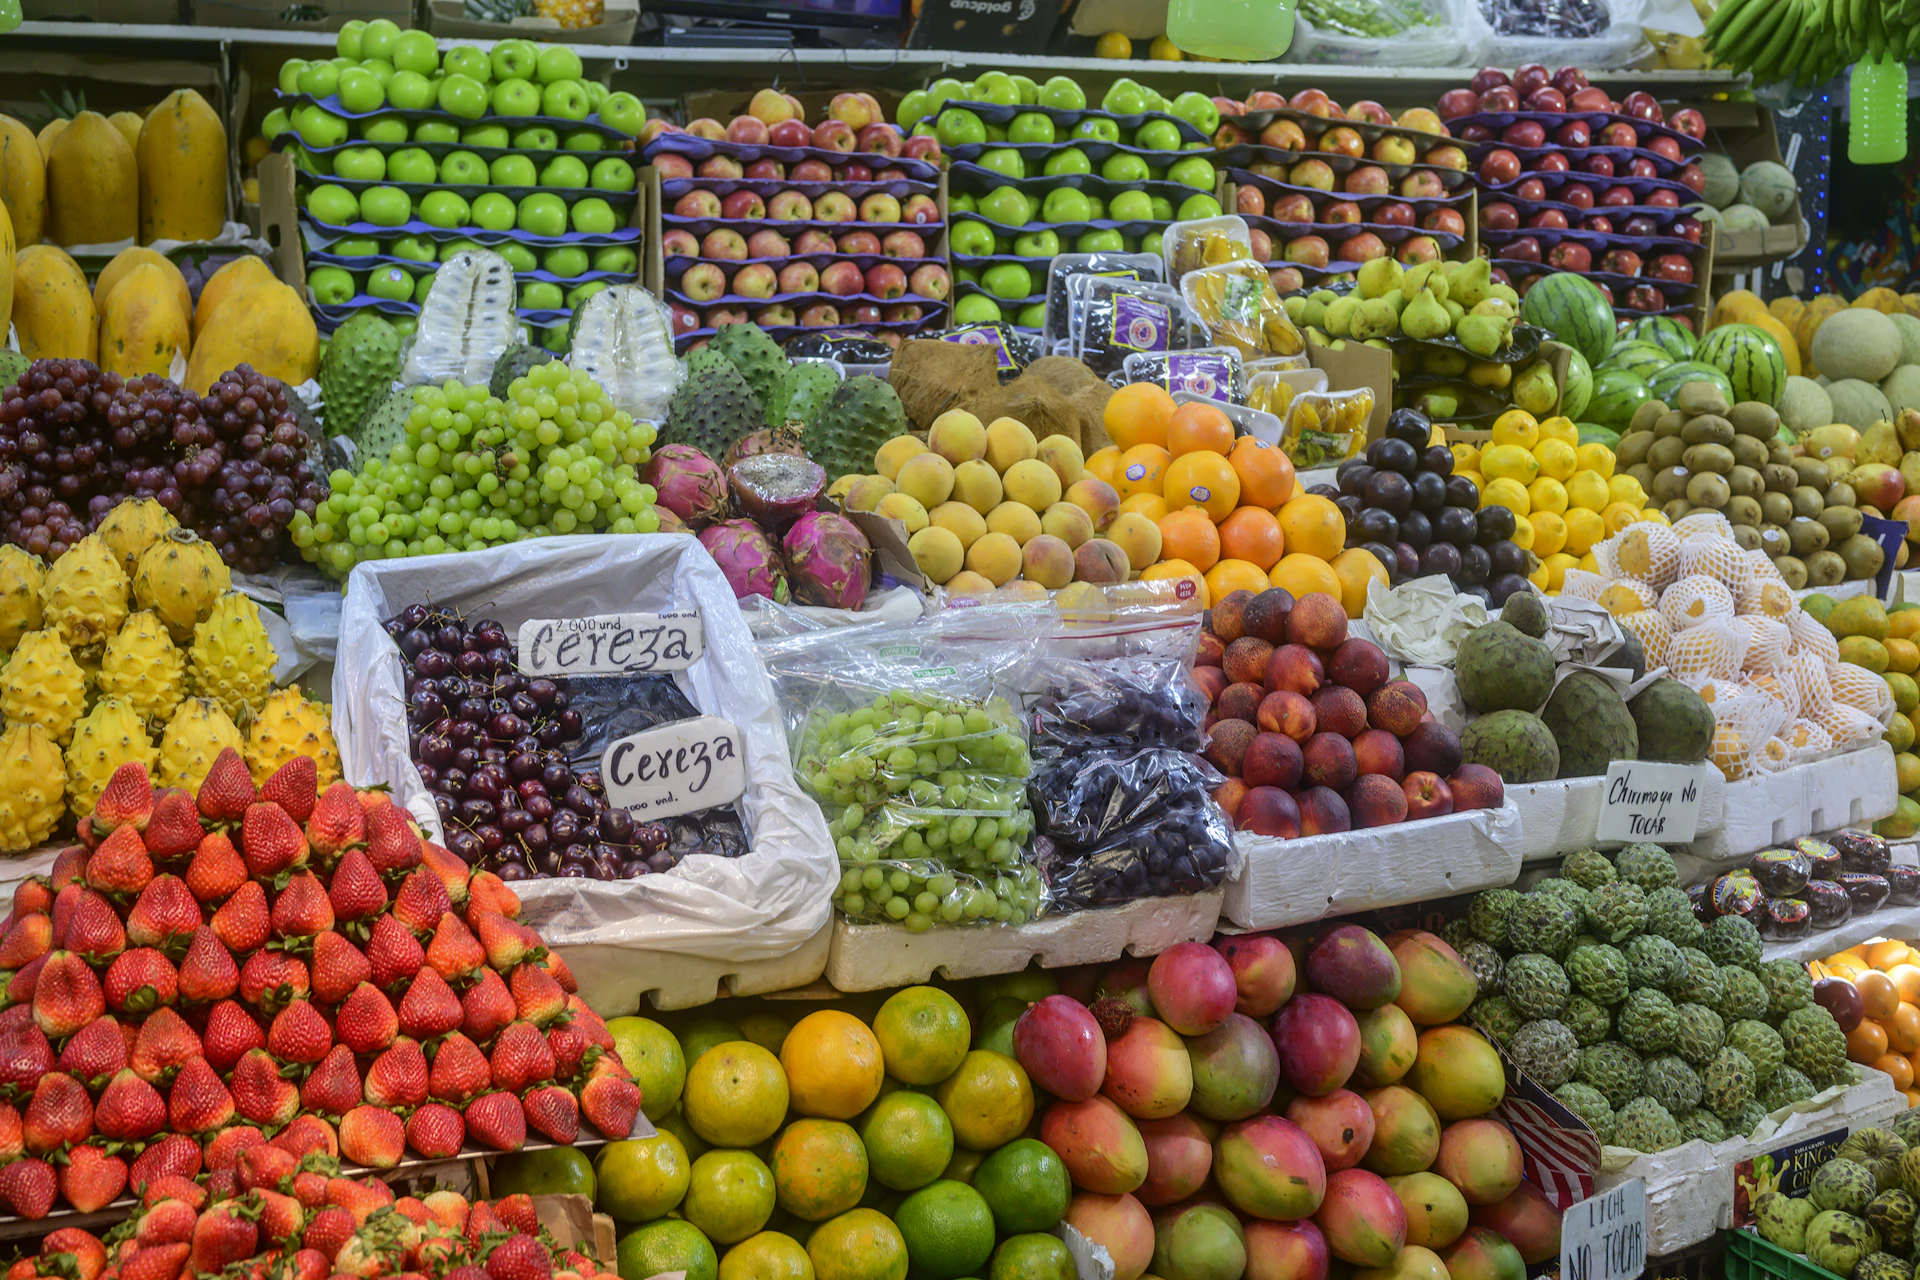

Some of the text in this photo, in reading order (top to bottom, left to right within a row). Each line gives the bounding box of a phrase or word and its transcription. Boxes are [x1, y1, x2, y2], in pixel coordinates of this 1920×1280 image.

[530, 624, 694, 671] Cereza
[555, 616, 624, 632] 2.000 und.
[610, 736, 736, 793] Cereza
[1608, 769, 1673, 817] Chirimoya
[1629, 814, 1666, 835] TOCAR
[1793, 1142, 1838, 1172] KING'S
[1568, 1220, 1643, 1280] NO TOCAR
